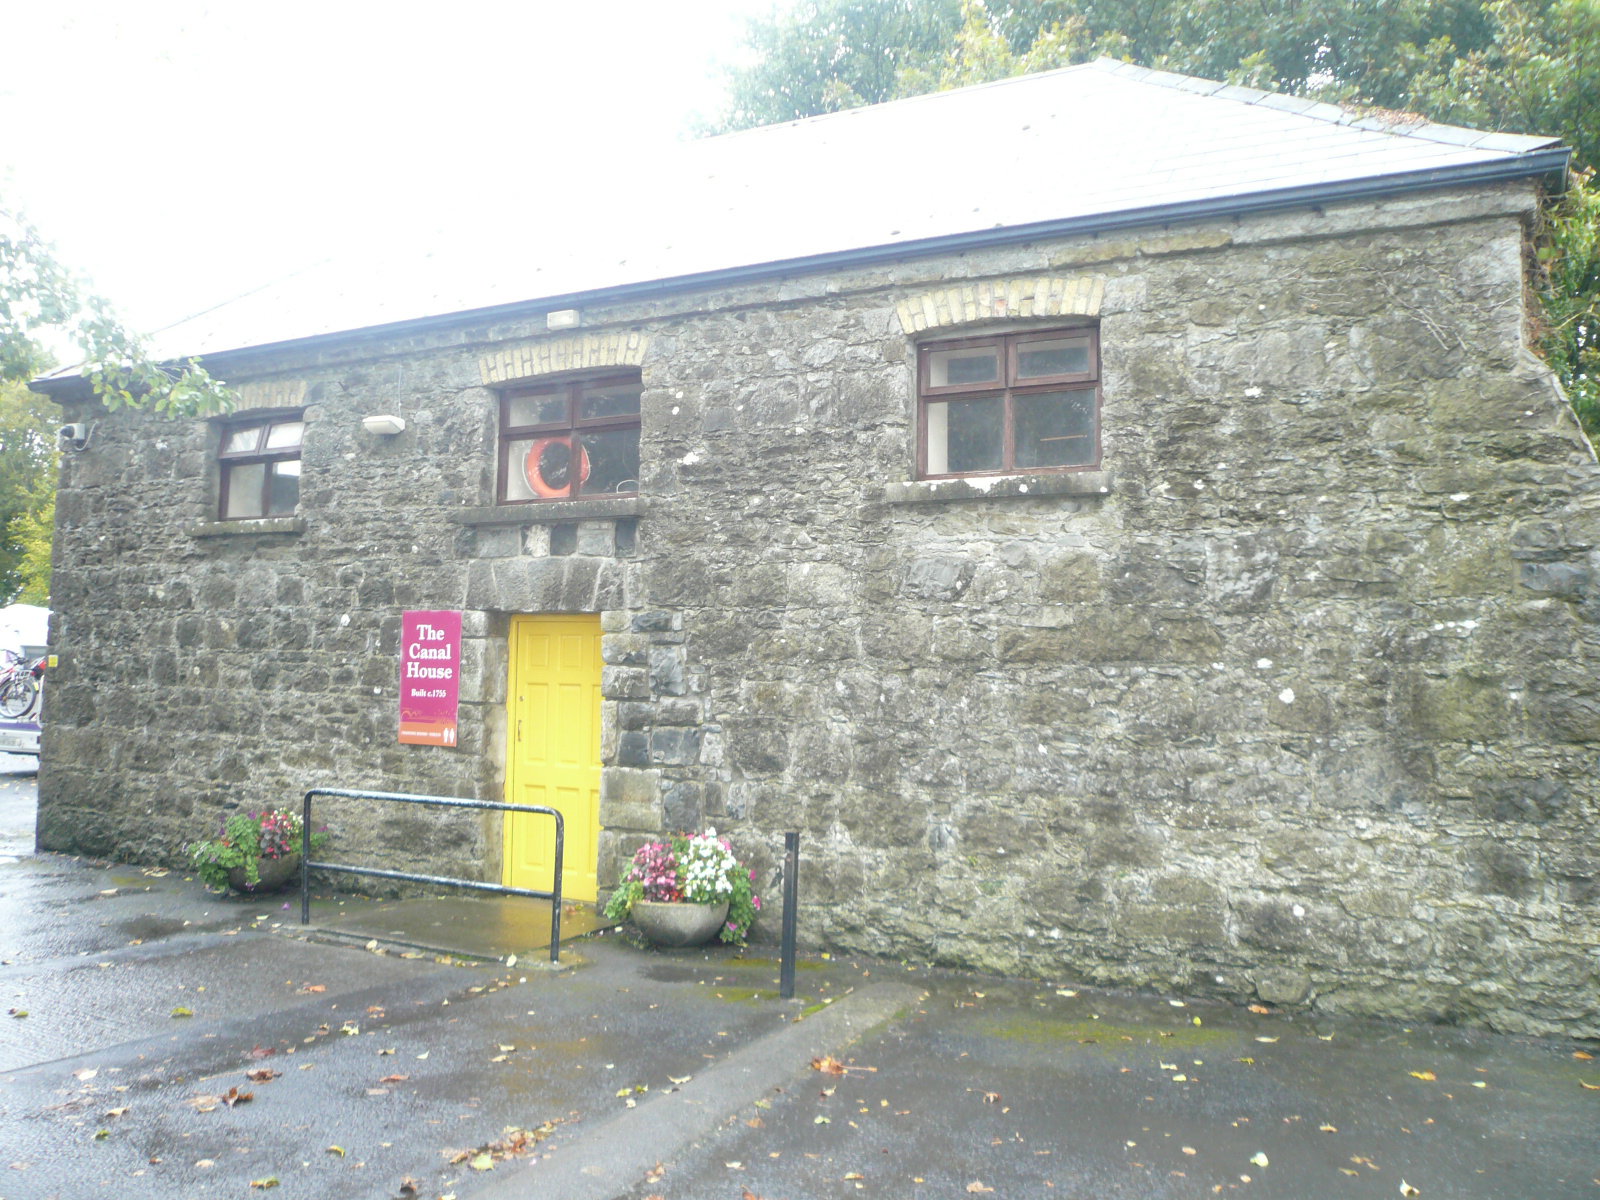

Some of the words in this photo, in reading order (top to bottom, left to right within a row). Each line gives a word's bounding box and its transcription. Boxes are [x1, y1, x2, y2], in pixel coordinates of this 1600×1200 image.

[416, 624, 445, 641] The
[409, 643, 452, 660] Canal
[406, 661, 453, 679] House
[411, 688, 427, 697] Built
